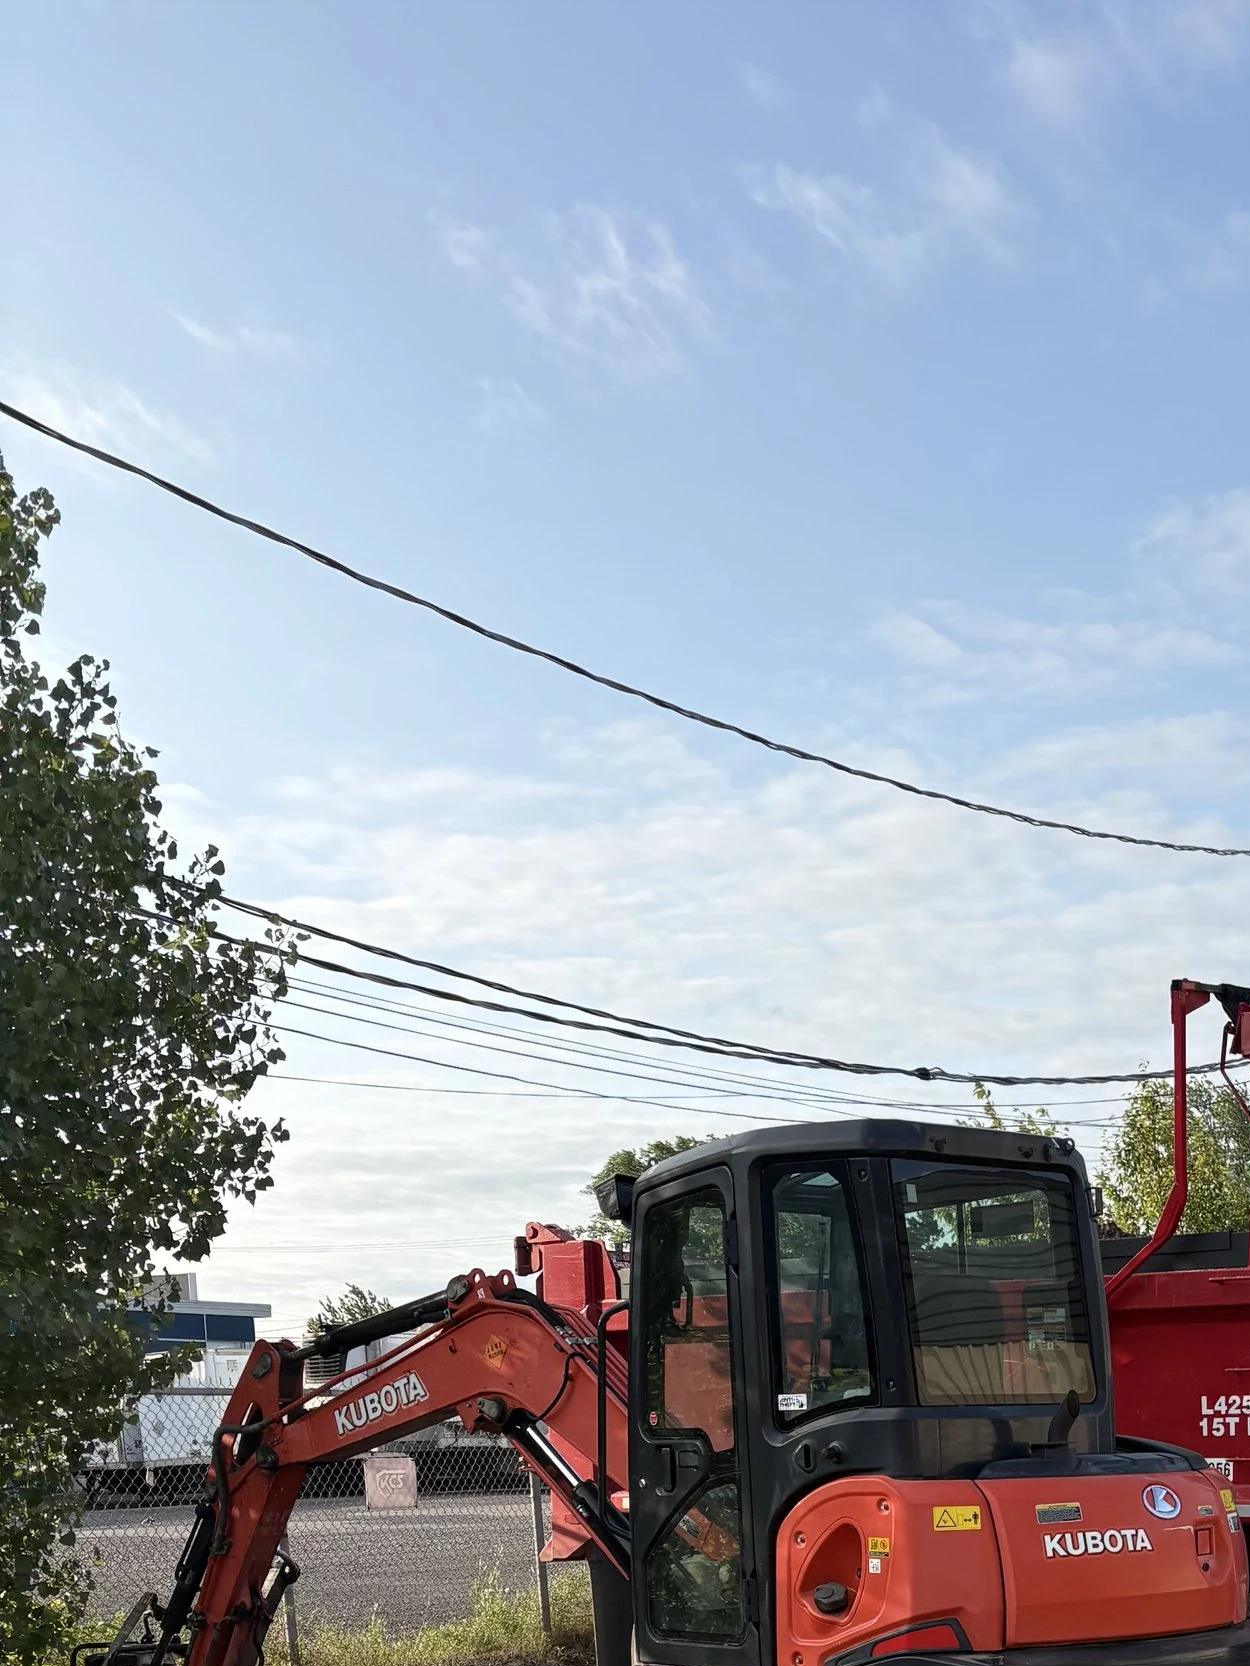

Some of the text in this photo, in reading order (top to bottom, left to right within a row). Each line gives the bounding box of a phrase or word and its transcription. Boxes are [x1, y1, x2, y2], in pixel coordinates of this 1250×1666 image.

[333, 1371, 428, 1437] KUBOTA
[1199, 1417, 1240, 1437] 15T
[1043, 1528, 1154, 1559] KUBOTA
